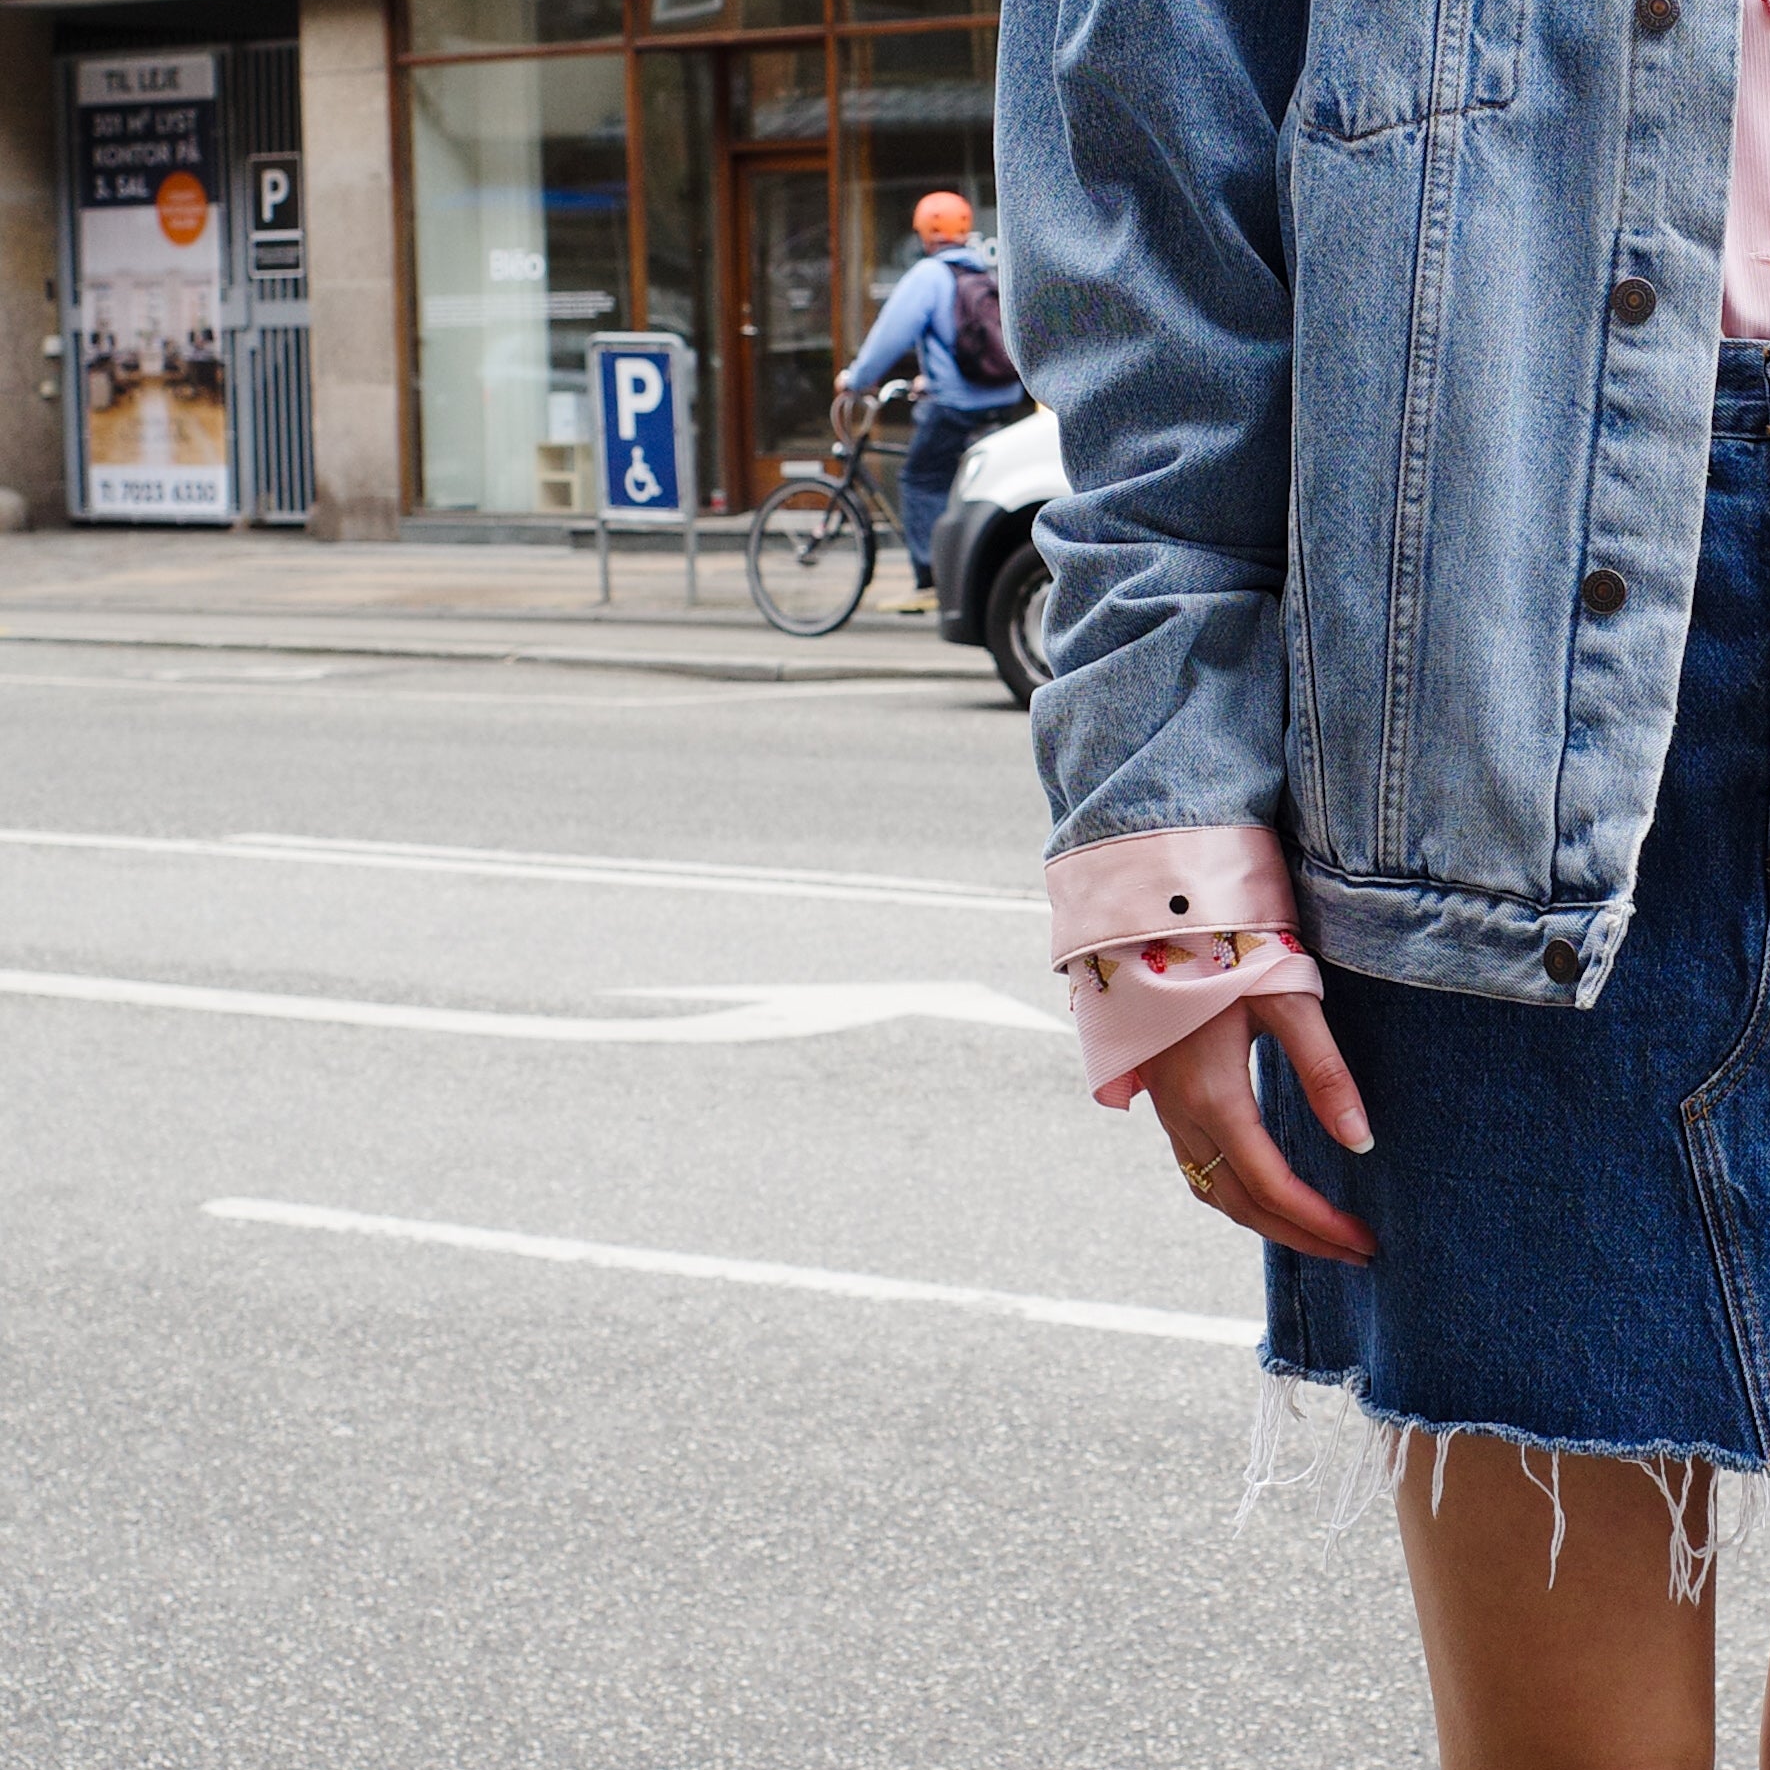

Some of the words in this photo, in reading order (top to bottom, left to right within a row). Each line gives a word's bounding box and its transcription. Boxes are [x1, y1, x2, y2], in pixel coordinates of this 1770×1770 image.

[105, 69, 131, 93] TIL
[138, 66, 179, 92] LEJE
[94, 141, 171, 167] KONTOR
[261, 168, 290, 224] P
[614, 357, 664, 441] P
